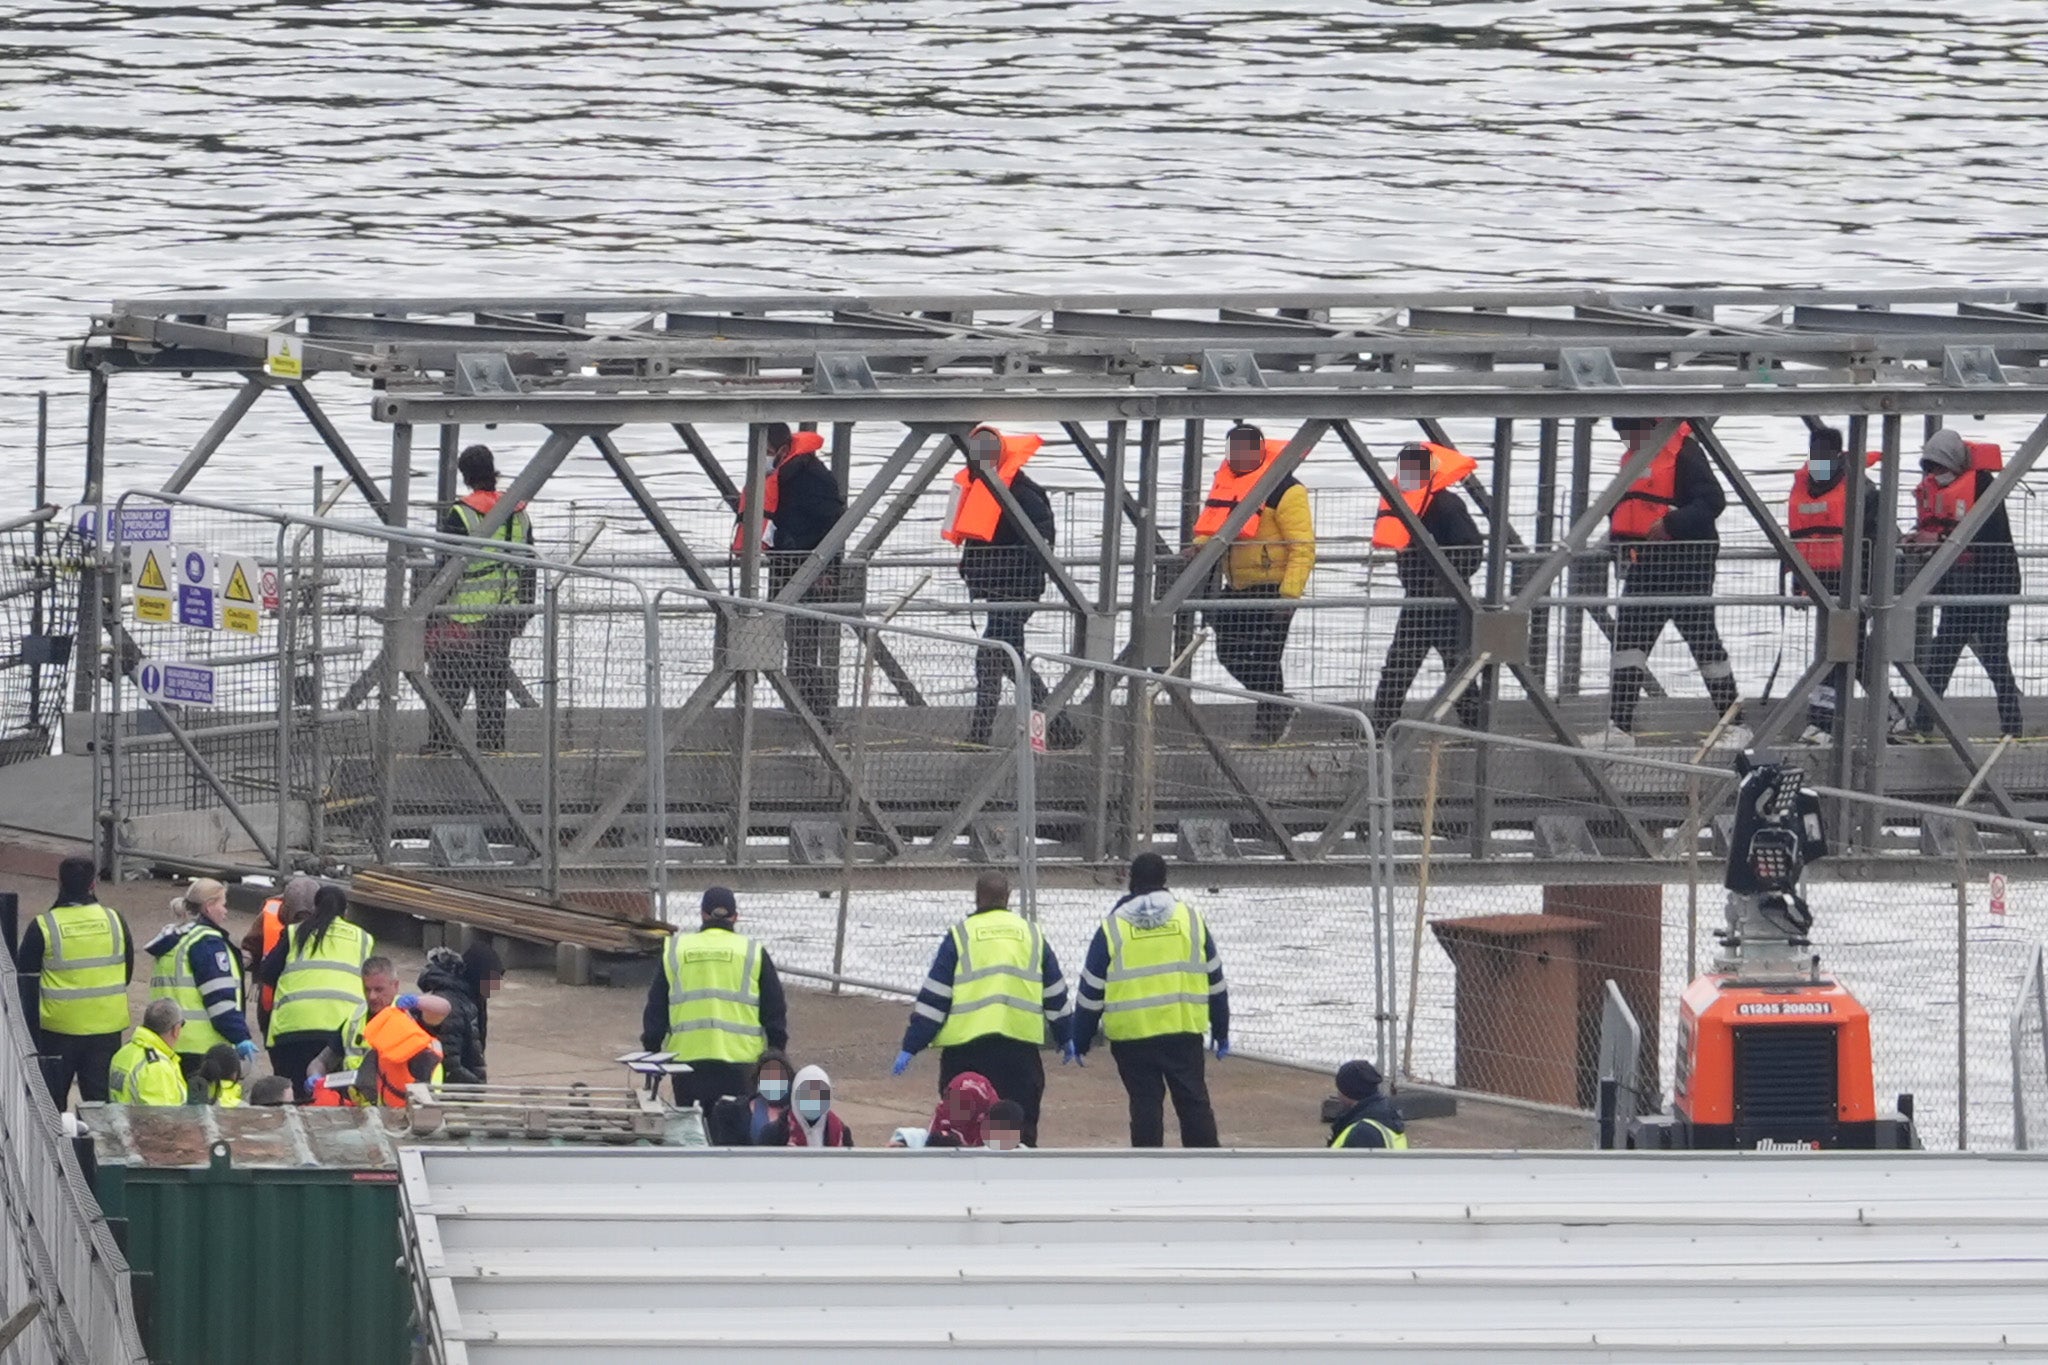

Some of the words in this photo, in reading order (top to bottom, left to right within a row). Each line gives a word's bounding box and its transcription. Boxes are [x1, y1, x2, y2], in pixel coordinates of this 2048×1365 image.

[154, 510, 167, 520] OF
[124, 520, 166, 529] PERSONS
[123, 530, 144, 539] LINK
[145, 530, 168, 539] SPAN
[227, 608, 251, 619] Caution
[200, 672, 210, 682] OF
[1740, 1004, 1780, 1014] 01245
